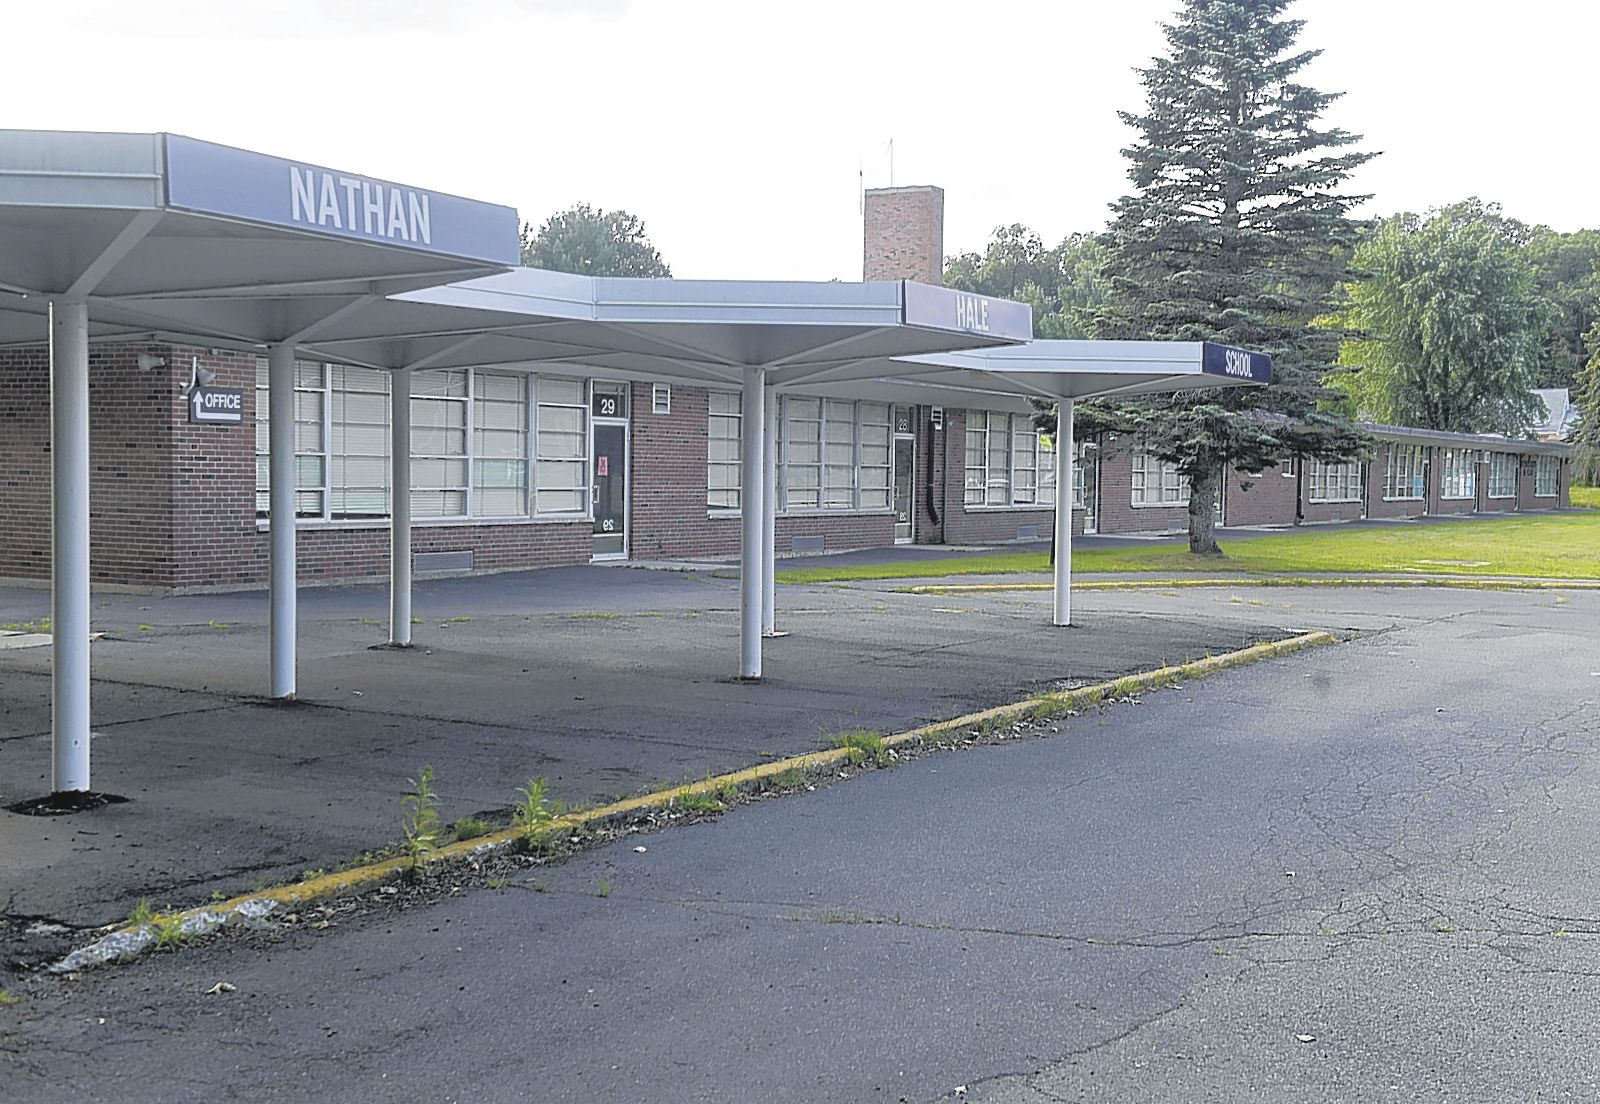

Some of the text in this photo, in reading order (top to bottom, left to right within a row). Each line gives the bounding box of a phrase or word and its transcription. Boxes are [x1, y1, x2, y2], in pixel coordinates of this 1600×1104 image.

[290, 166, 431, 244] NATHAN
[956, 294, 989, 331] HALE
[1225, 349, 1253, 378] SCHOOL
[205, 393, 241, 409] OFFICE
[601, 398, 615, 414] 29
[898, 418, 907, 431] 28
